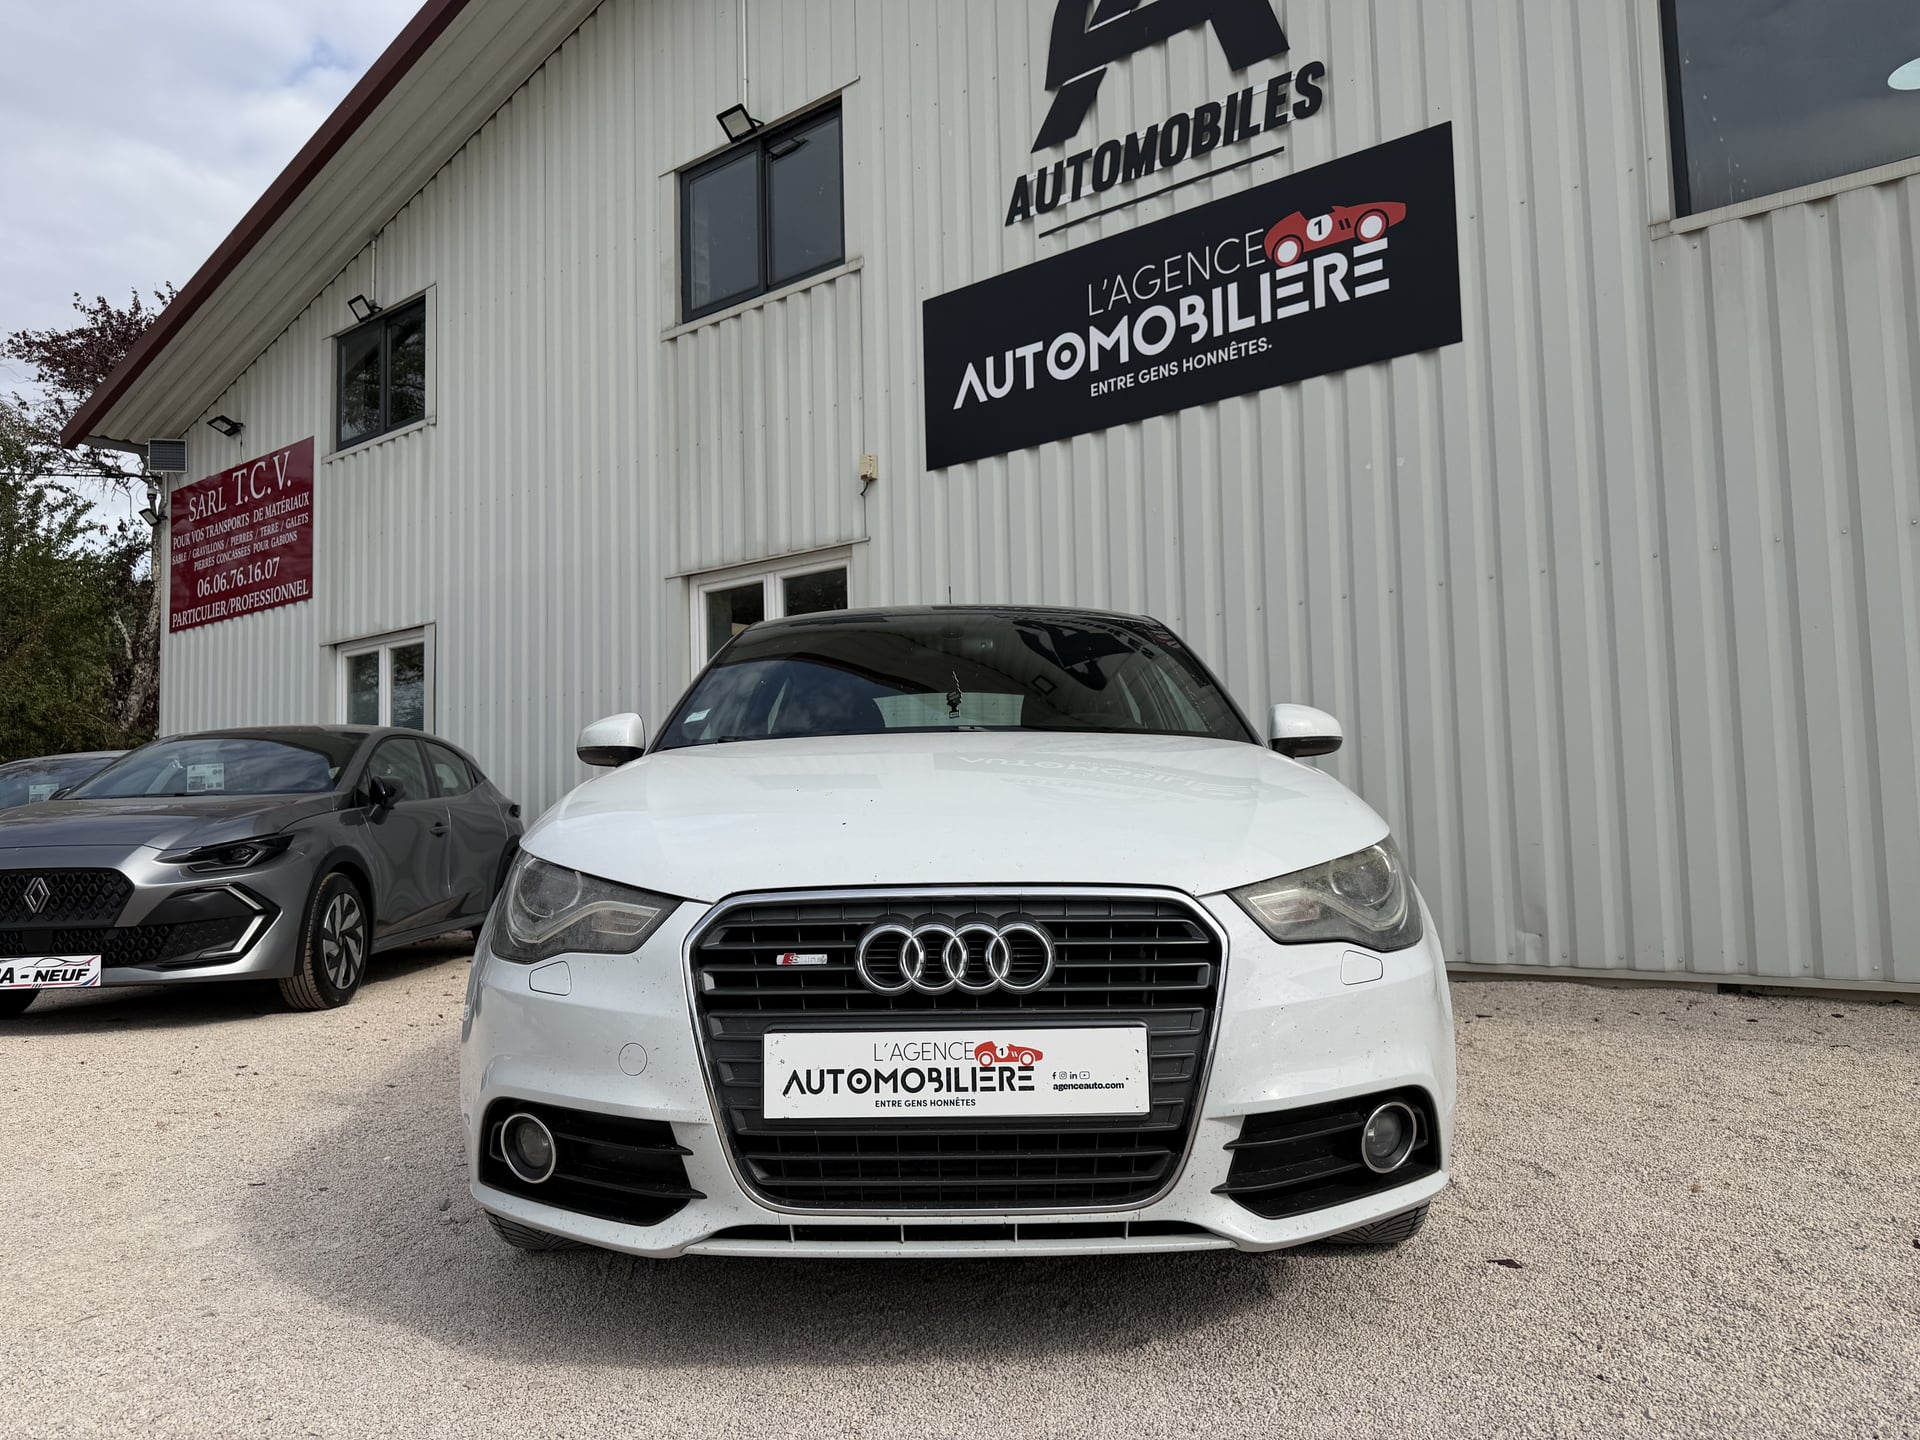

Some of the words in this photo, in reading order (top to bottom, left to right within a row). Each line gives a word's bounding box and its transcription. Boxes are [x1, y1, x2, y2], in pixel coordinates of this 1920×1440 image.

[1005, 61, 1325, 227] AUTOMOBILES
[1088, 228, 1266, 316] L'AGENCE
[1090, 373, 1135, 397] ENTRE
[1138, 362, 1179, 384] GENS
[1182, 337, 1273, 373] HONNÊTES.
[173, 534, 191, 550] POUR
[191, 529, 204, 542] VOS
[205, 512, 250, 538] TRANSPORTS
[253, 509, 264, 523] DE
[264, 491, 310, 519] MATÉRIAUX
[188, 486, 227, 522] SARL
[172, 552, 187, 566] SABLE
[192, 540, 225, 558] GRAVILLONS
[230, 531, 254, 547] PIERRES
[260, 522, 279, 537] TERRE
[285, 513, 309, 529] GALETS
[194, 556, 215, 571] PIERRES
[216, 544, 251, 564] CONCASSÉES
[253, 539, 269, 554] POUR
[271, 530, 298, 548] GABIONS
[197, 557, 280, 598] 06.06.76.16.07
[172, 579, 309, 628] PARTICULIER/PROFESSIONNEL
[33, 968, 90, 983] NEUF
[873, 1041, 975, 1062] L'AGENCE
[875, 1099, 902, 1108] ENTRE
[904, 1098, 928, 1107] GENS
[929, 1096, 976, 1107] HONNÊTES
[1052, 1082, 1124, 1091] agenceauto.com
